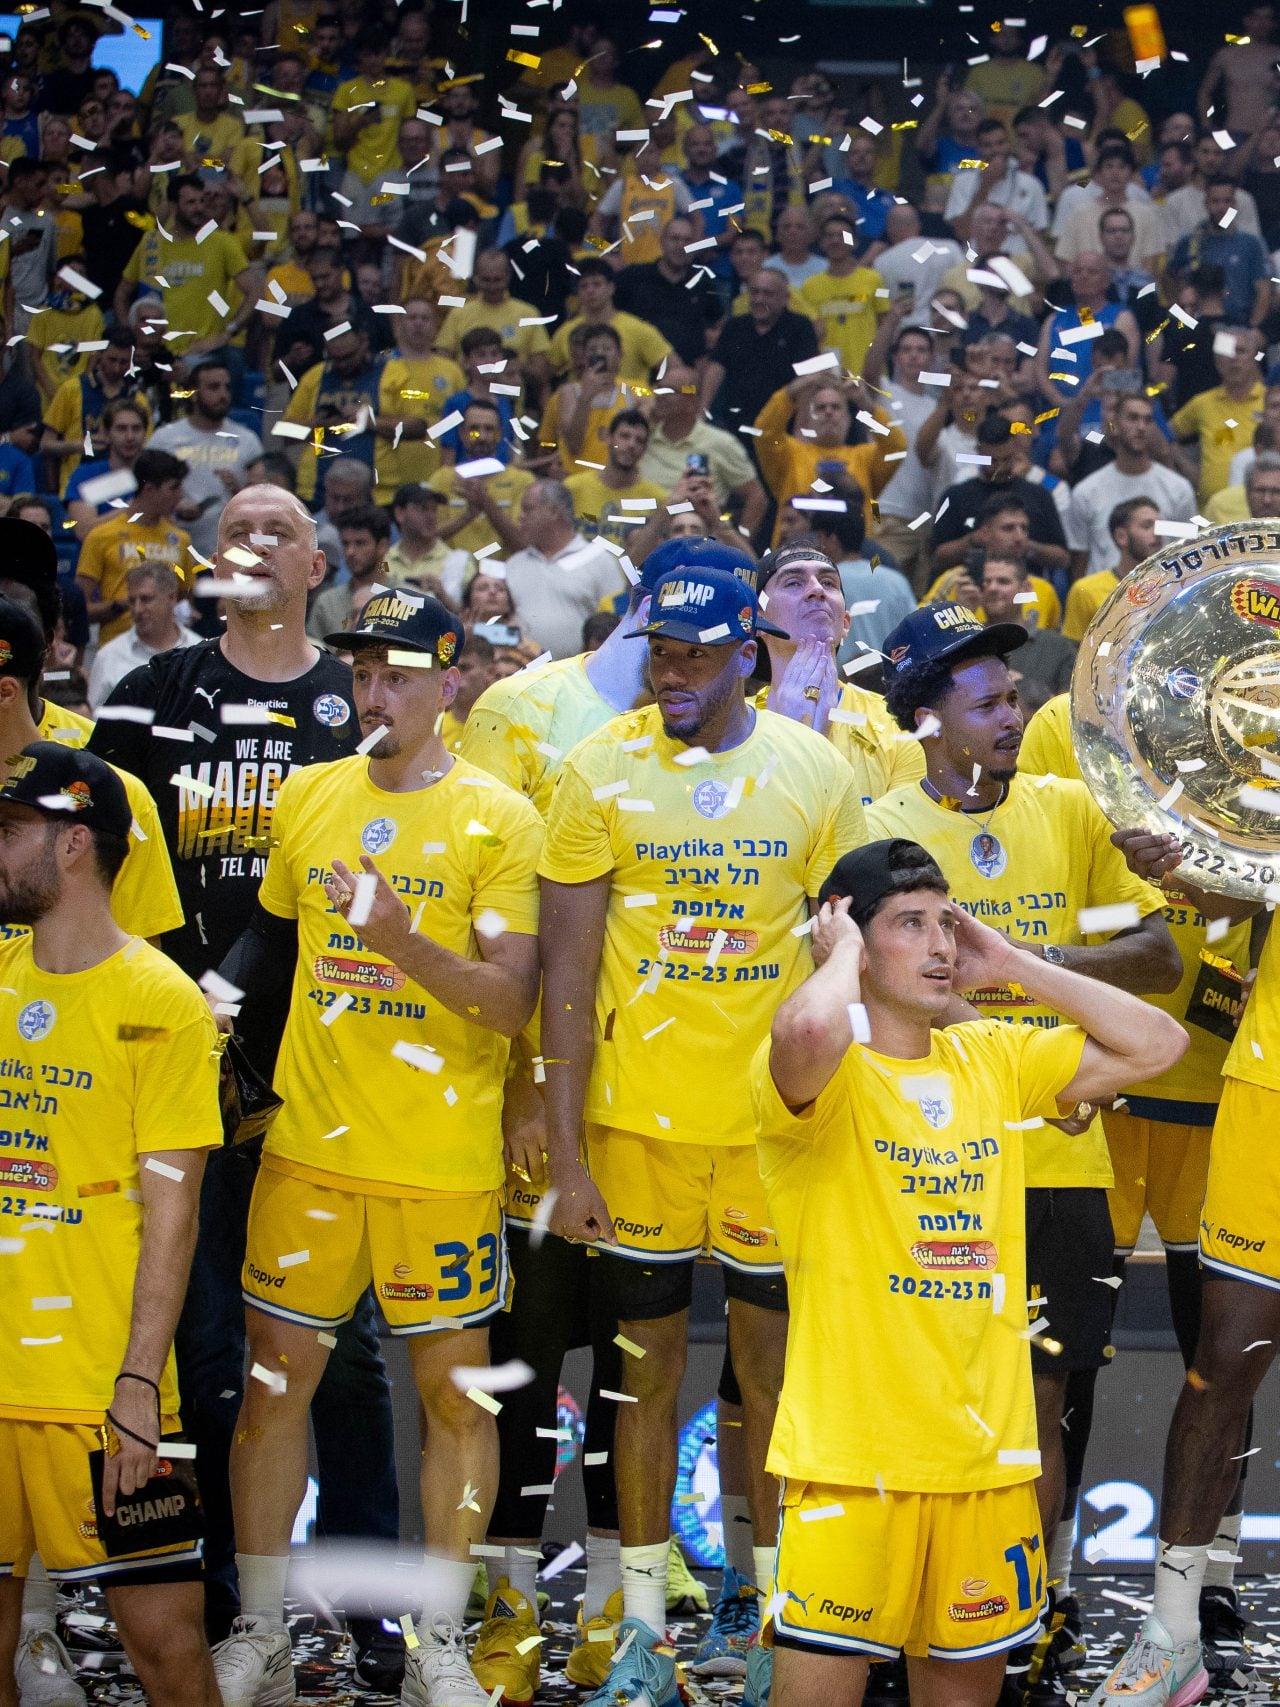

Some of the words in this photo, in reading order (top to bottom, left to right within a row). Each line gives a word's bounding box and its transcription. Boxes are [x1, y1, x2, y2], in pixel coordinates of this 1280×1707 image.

[235, 738, 258, 760] WE
[263, 741, 292, 761] ARE
[635, 838, 724, 863] Playtika
[733, 839, 788, 858] מכבי
[220, 857, 245, 878] TEL
[665, 867, 720, 885] אביב
[727, 863, 760, 886] תל
[391, 874, 444, 898] מכבי
[672, 898, 745, 920] אלופת
[952, 897, 1012, 918] laytika
[1017, 891, 1067, 910] מכבי
[1016, 919, 1048, 937] תל
[321, 961, 378, 984] Winner
[379, 974, 393, 987] סל
[637, 958, 728, 983] 222-23
[734, 963, 780, 982] עונת
[377, 999, 426, 1019] עונת
[41, 1064, 93, 1090] מכבי
[33, 1087, 58, 1116] תל
[900, 1174, 957, 1195] אביב
[960, 1168, 984, 1194] תל
[613, 1217, 663, 1238] Rapyd
[918, 1209, 983, 1231] אלופת
[1216, 1228, 1266, 1253] Rapyd
[433, 1232, 498, 1302] 33
[917, 1249, 972, 1265] Winner
[973, 1252, 987, 1266] סל
[248, 1263, 286, 1289] Rapyd
[888, 1274, 974, 1299] 2022-23
[116, 1494, 186, 1527] CHAMP
[819, 1598, 875, 1623] Rapyd
[953, 1603, 995, 1620] Winner
